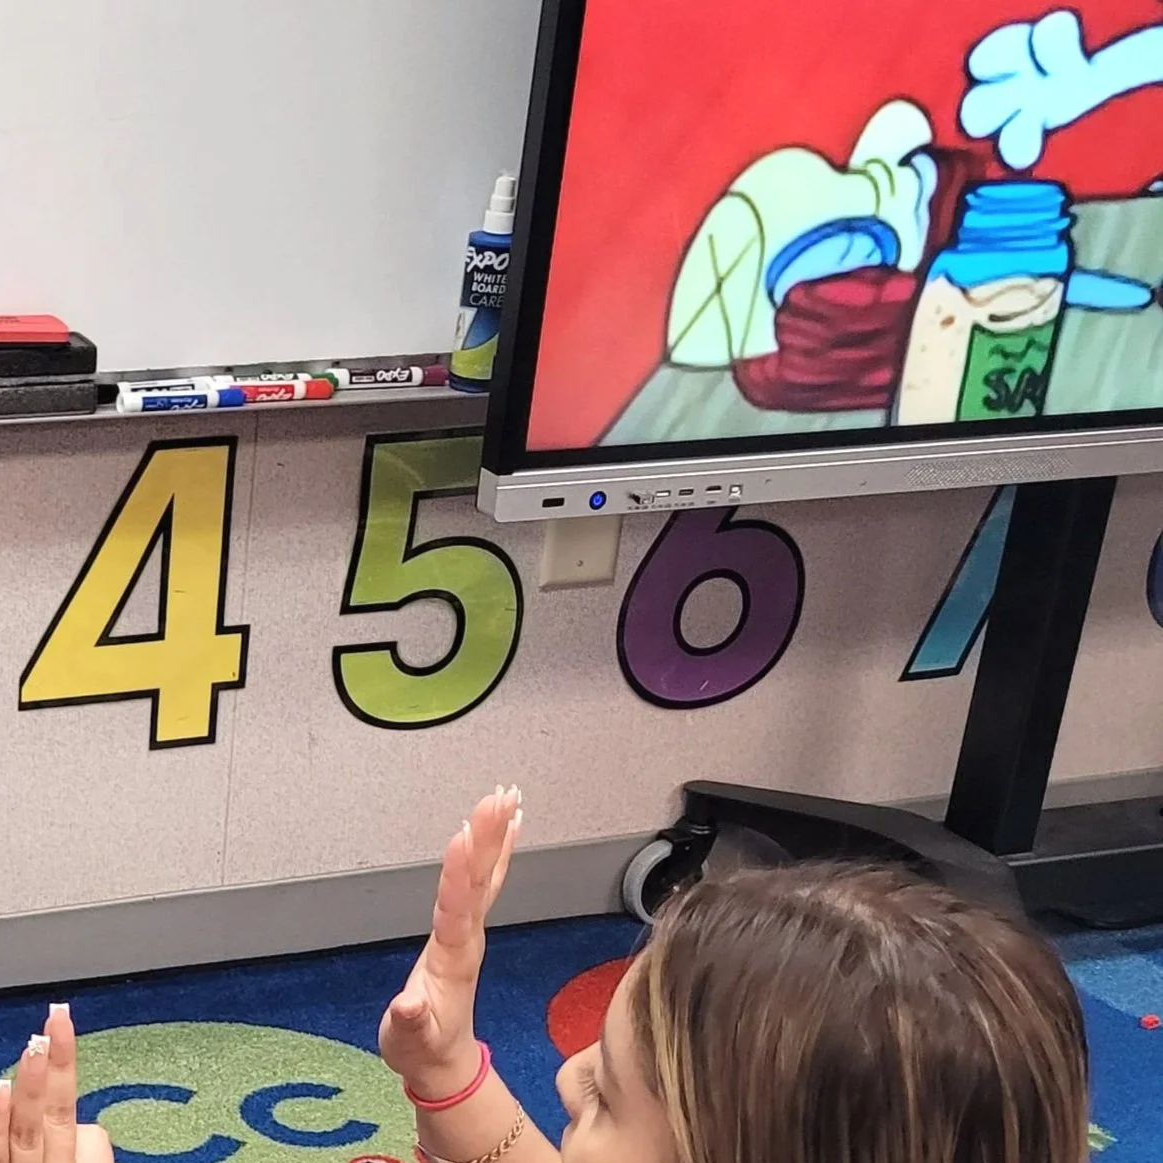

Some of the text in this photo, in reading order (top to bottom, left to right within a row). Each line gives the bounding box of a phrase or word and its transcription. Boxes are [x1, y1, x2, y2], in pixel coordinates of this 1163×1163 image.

[465, 246, 509, 272] EXPO
[473, 271, 507, 284] WHITE
[471, 282, 506, 294] BOARD
[469, 293, 505, 308] CARE
[18, 437, 250, 750] 4
[332, 427, 524, 731] 5
[615, 508, 805, 709] 6
[240, 1082, 378, 1147] c
